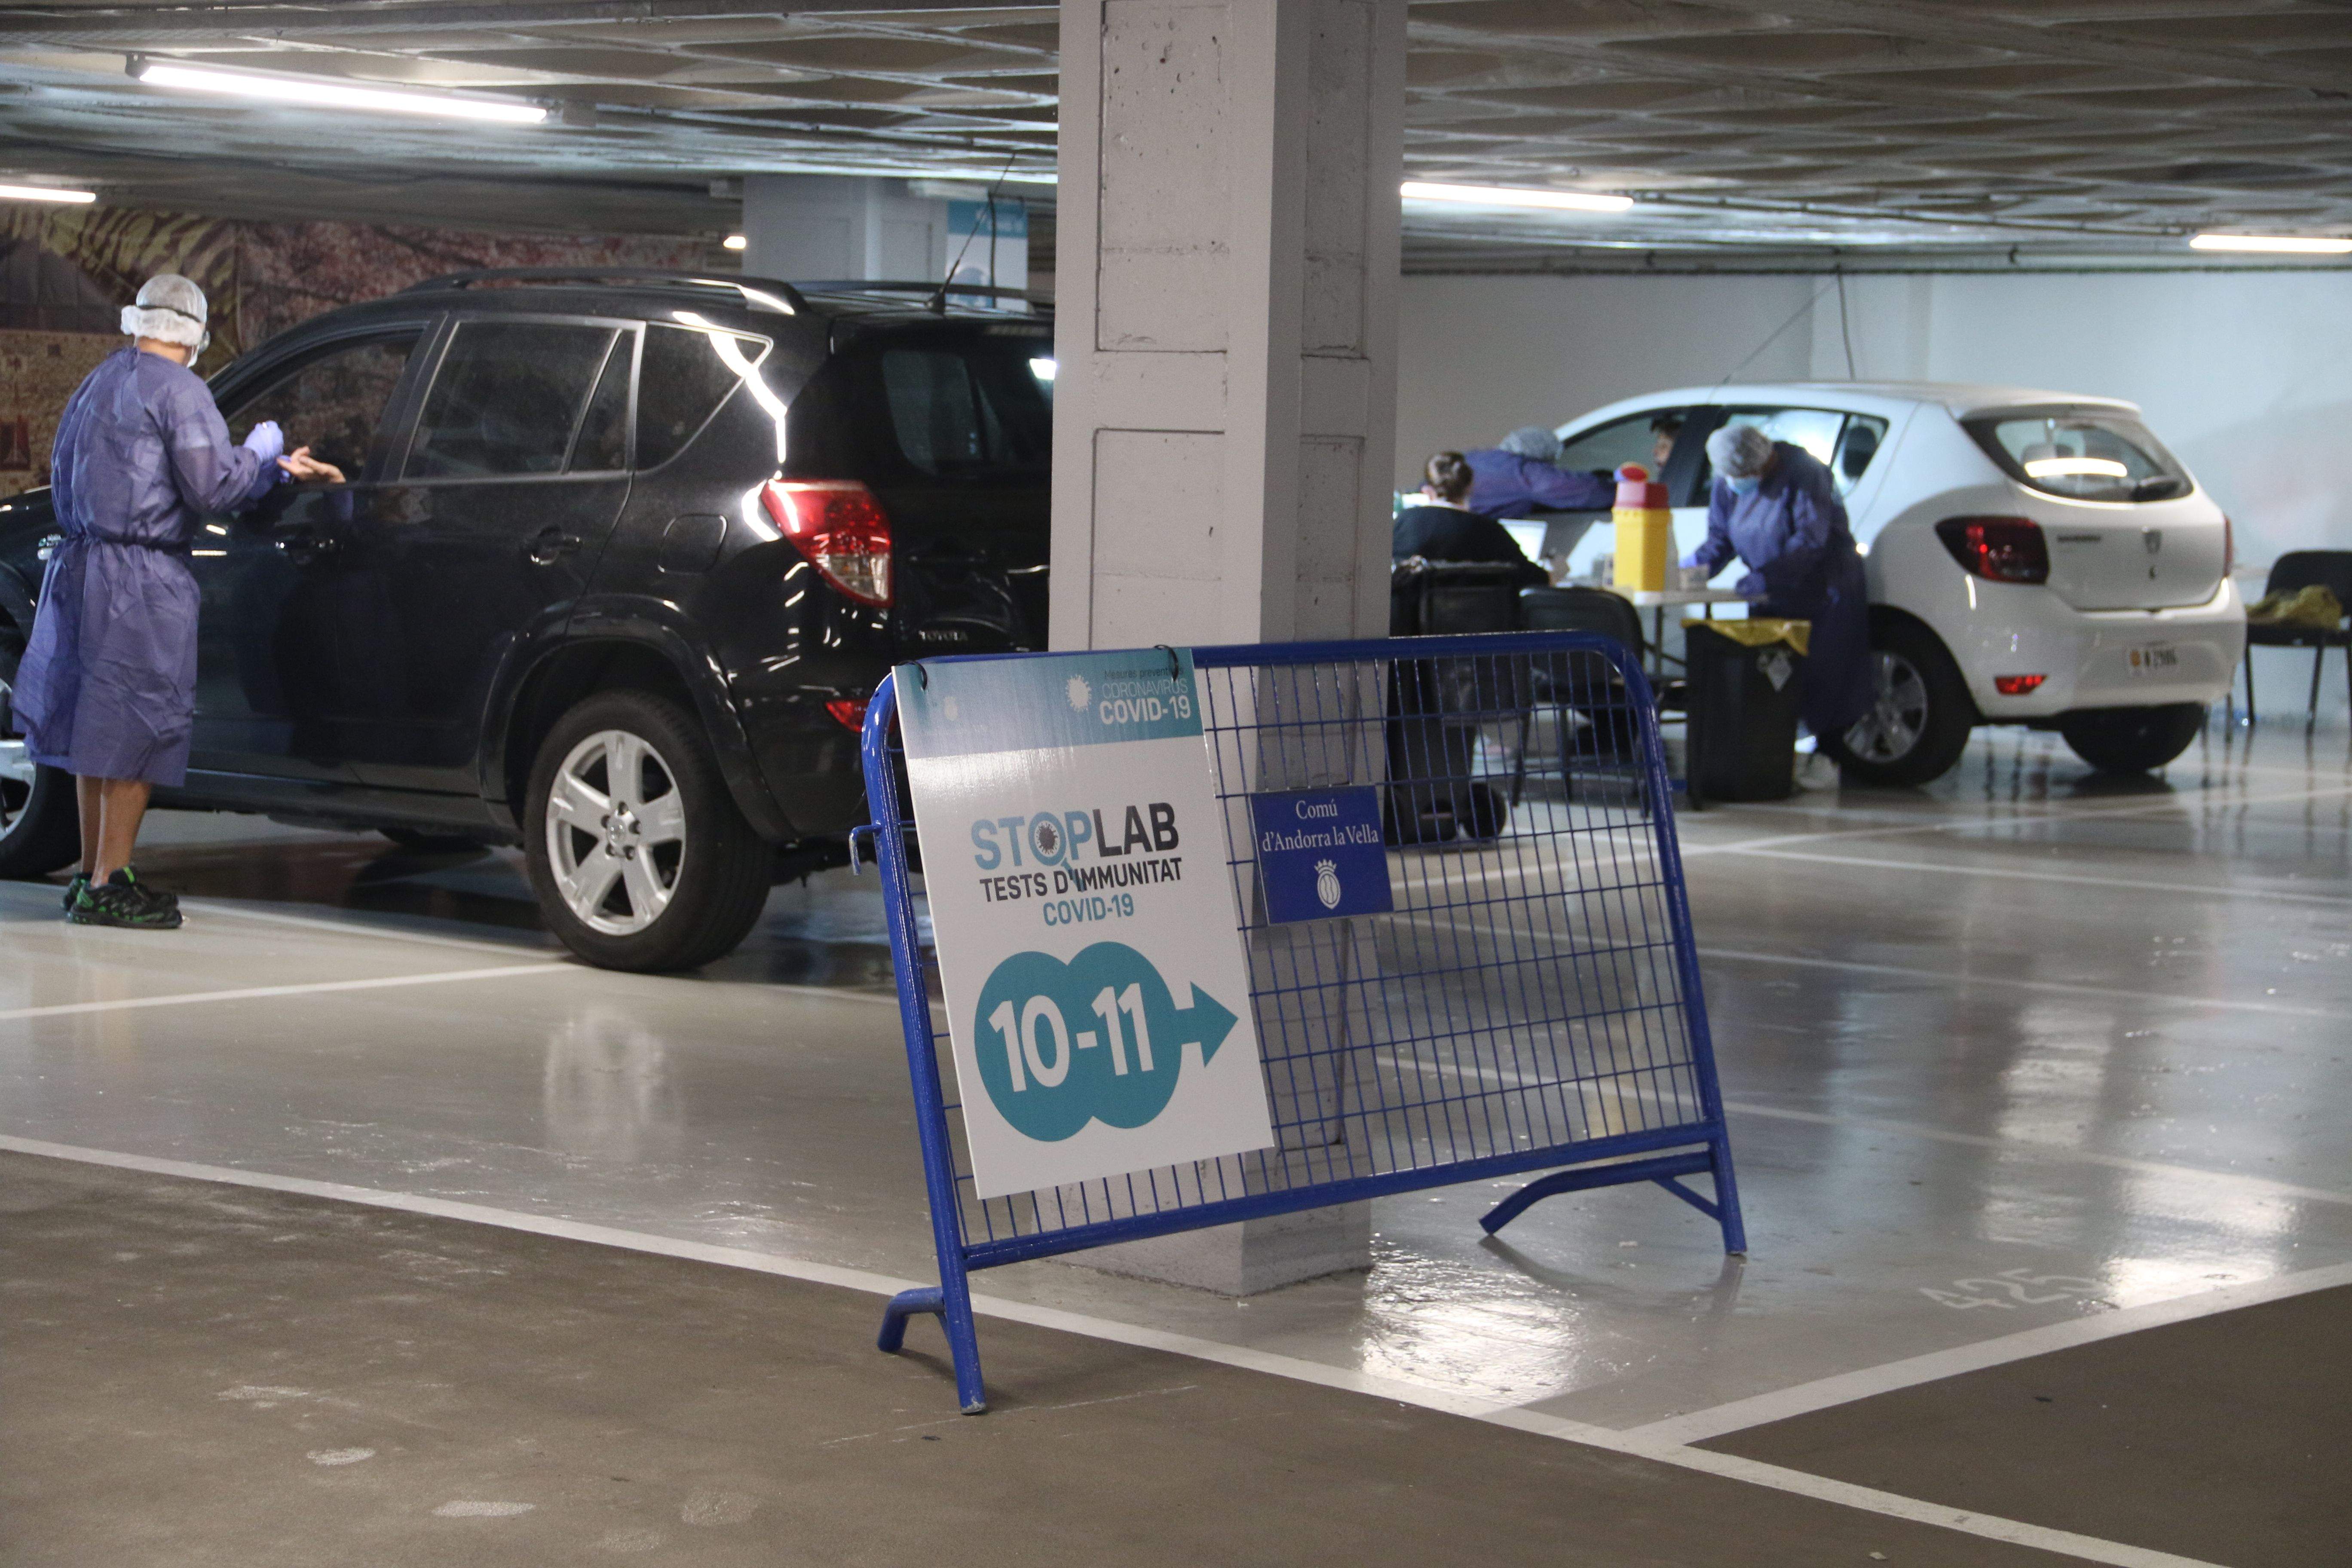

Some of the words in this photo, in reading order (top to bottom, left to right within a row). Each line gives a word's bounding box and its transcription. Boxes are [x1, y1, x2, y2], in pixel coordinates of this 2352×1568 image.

[1102, 677, 1188, 699] CORONAVIRUS
[1104, 669, 1137, 679] Mesures
[1139, 667, 1184, 679] prevents
[1099, 695, 1191, 725] COVID-19
[1296, 798, 1338, 819] Comú
[971, 802, 1179, 870] STOPLAB
[1333, 826, 1345, 845] la
[1345, 824, 1379, 844] Vella
[980, 873, 1047, 903] TESTS
[1055, 858, 1182, 895] D'IMMUNITAT
[1043, 893, 1134, 927] COVID-19
[988, 982, 1154, 1093] 10-11
